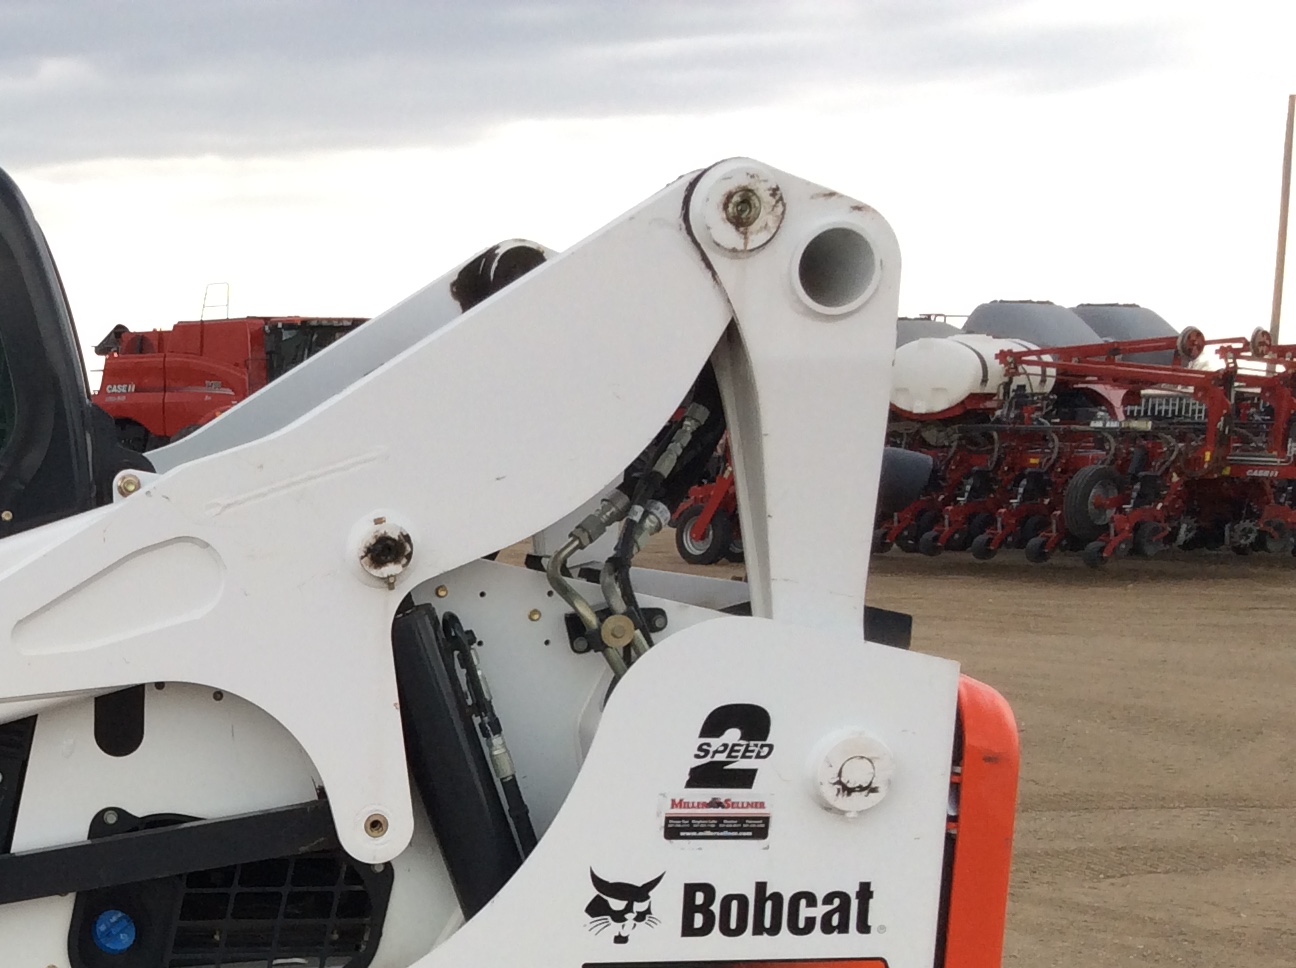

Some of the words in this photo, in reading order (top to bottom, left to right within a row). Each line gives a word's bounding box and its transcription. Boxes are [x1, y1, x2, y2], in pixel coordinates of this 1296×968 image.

[106, 384, 127, 393] CASE
[684, 703, 771, 789] 2
[693, 742, 774, 760] SPEED
[680, 881, 874, 938] Bobcat
